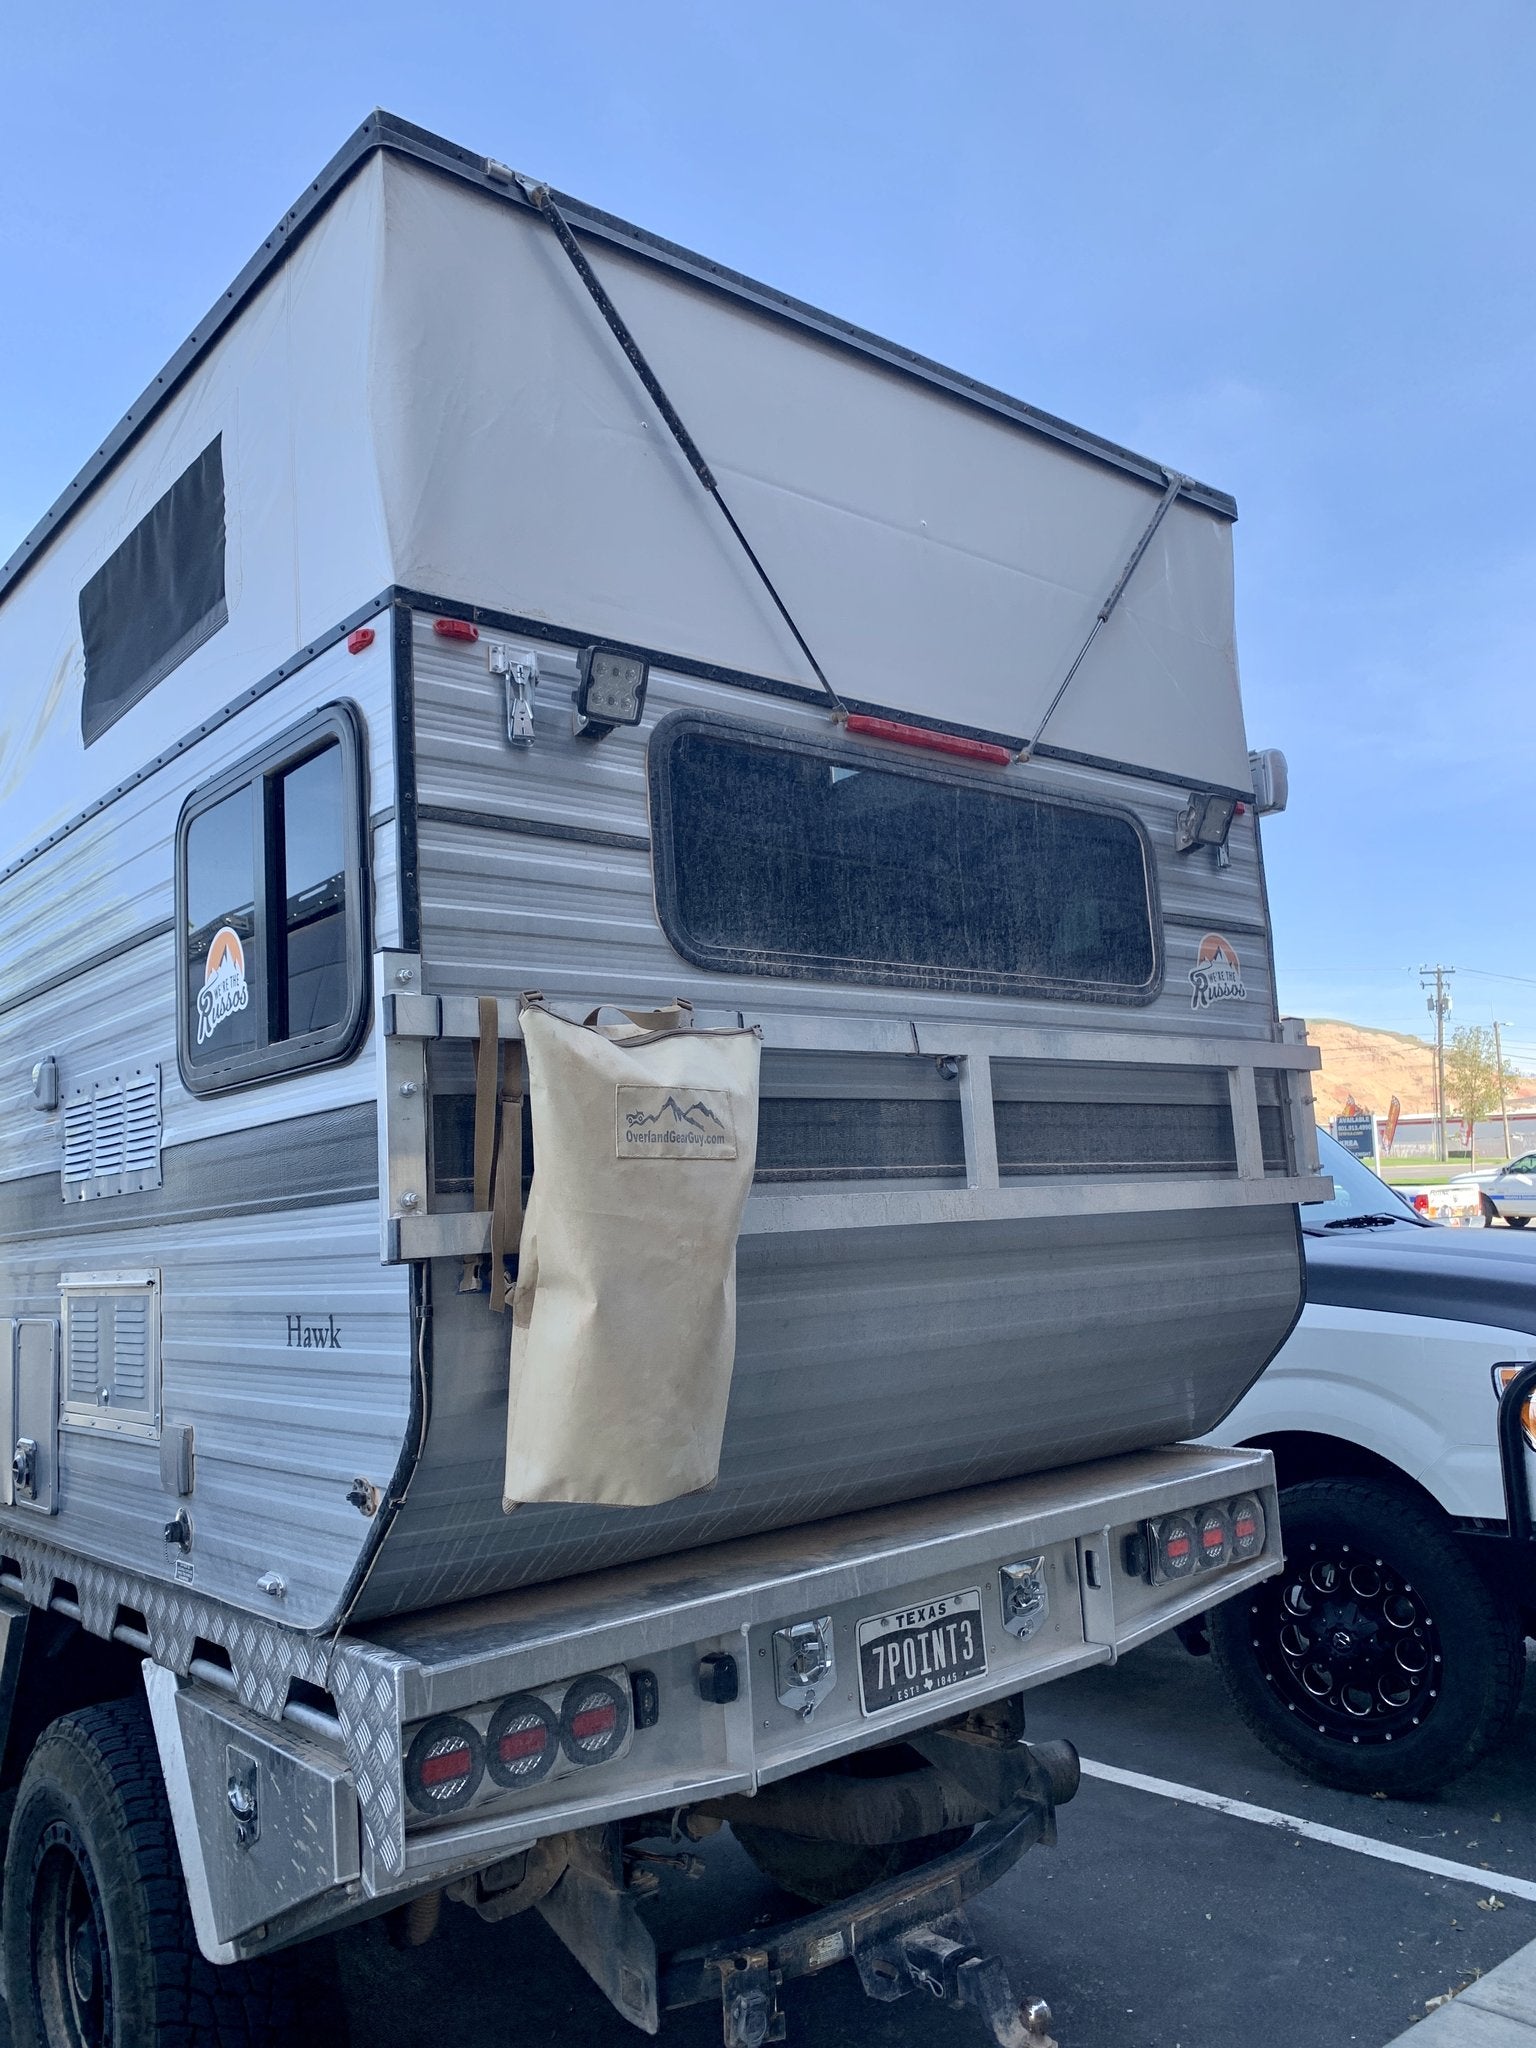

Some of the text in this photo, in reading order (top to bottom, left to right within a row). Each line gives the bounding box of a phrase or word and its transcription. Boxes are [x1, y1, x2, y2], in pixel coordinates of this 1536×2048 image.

[1190, 968, 1246, 1008] Russos
[199, 980, 247, 1041] Russos
[626, 1130, 725, 1147] OverlandGearGuy.com
[286, 1313, 342, 1348] Hawk
[896, 1602, 946, 1628] TEXAS
[937, 1672, 957, 1687] 1845
